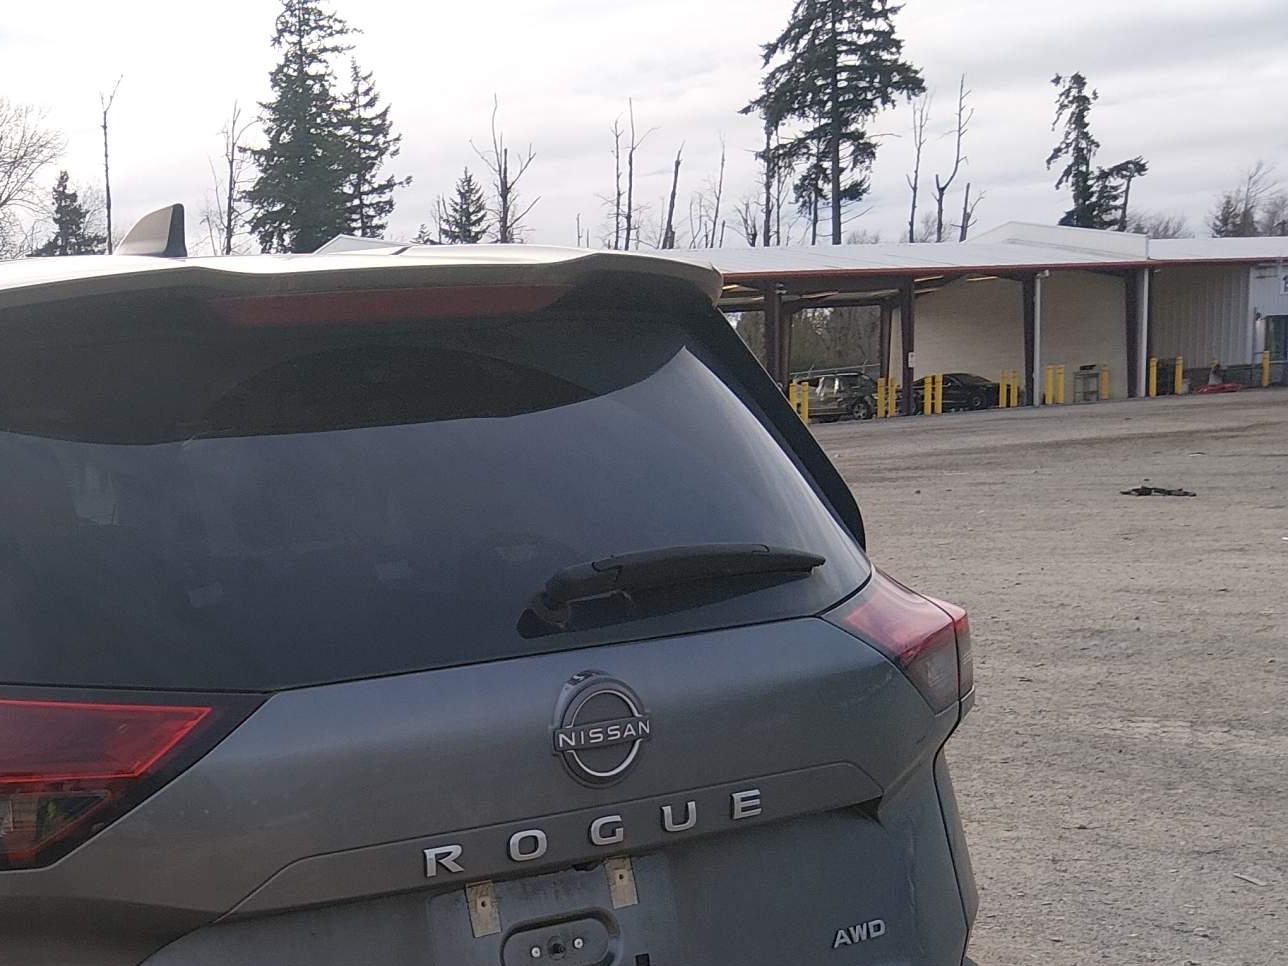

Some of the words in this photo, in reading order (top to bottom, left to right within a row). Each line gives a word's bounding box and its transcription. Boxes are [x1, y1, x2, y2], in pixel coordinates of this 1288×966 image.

[557, 718, 651, 749] NISSAN
[423, 787, 763, 879] ROGUE
[832, 918, 887, 950] AWD
